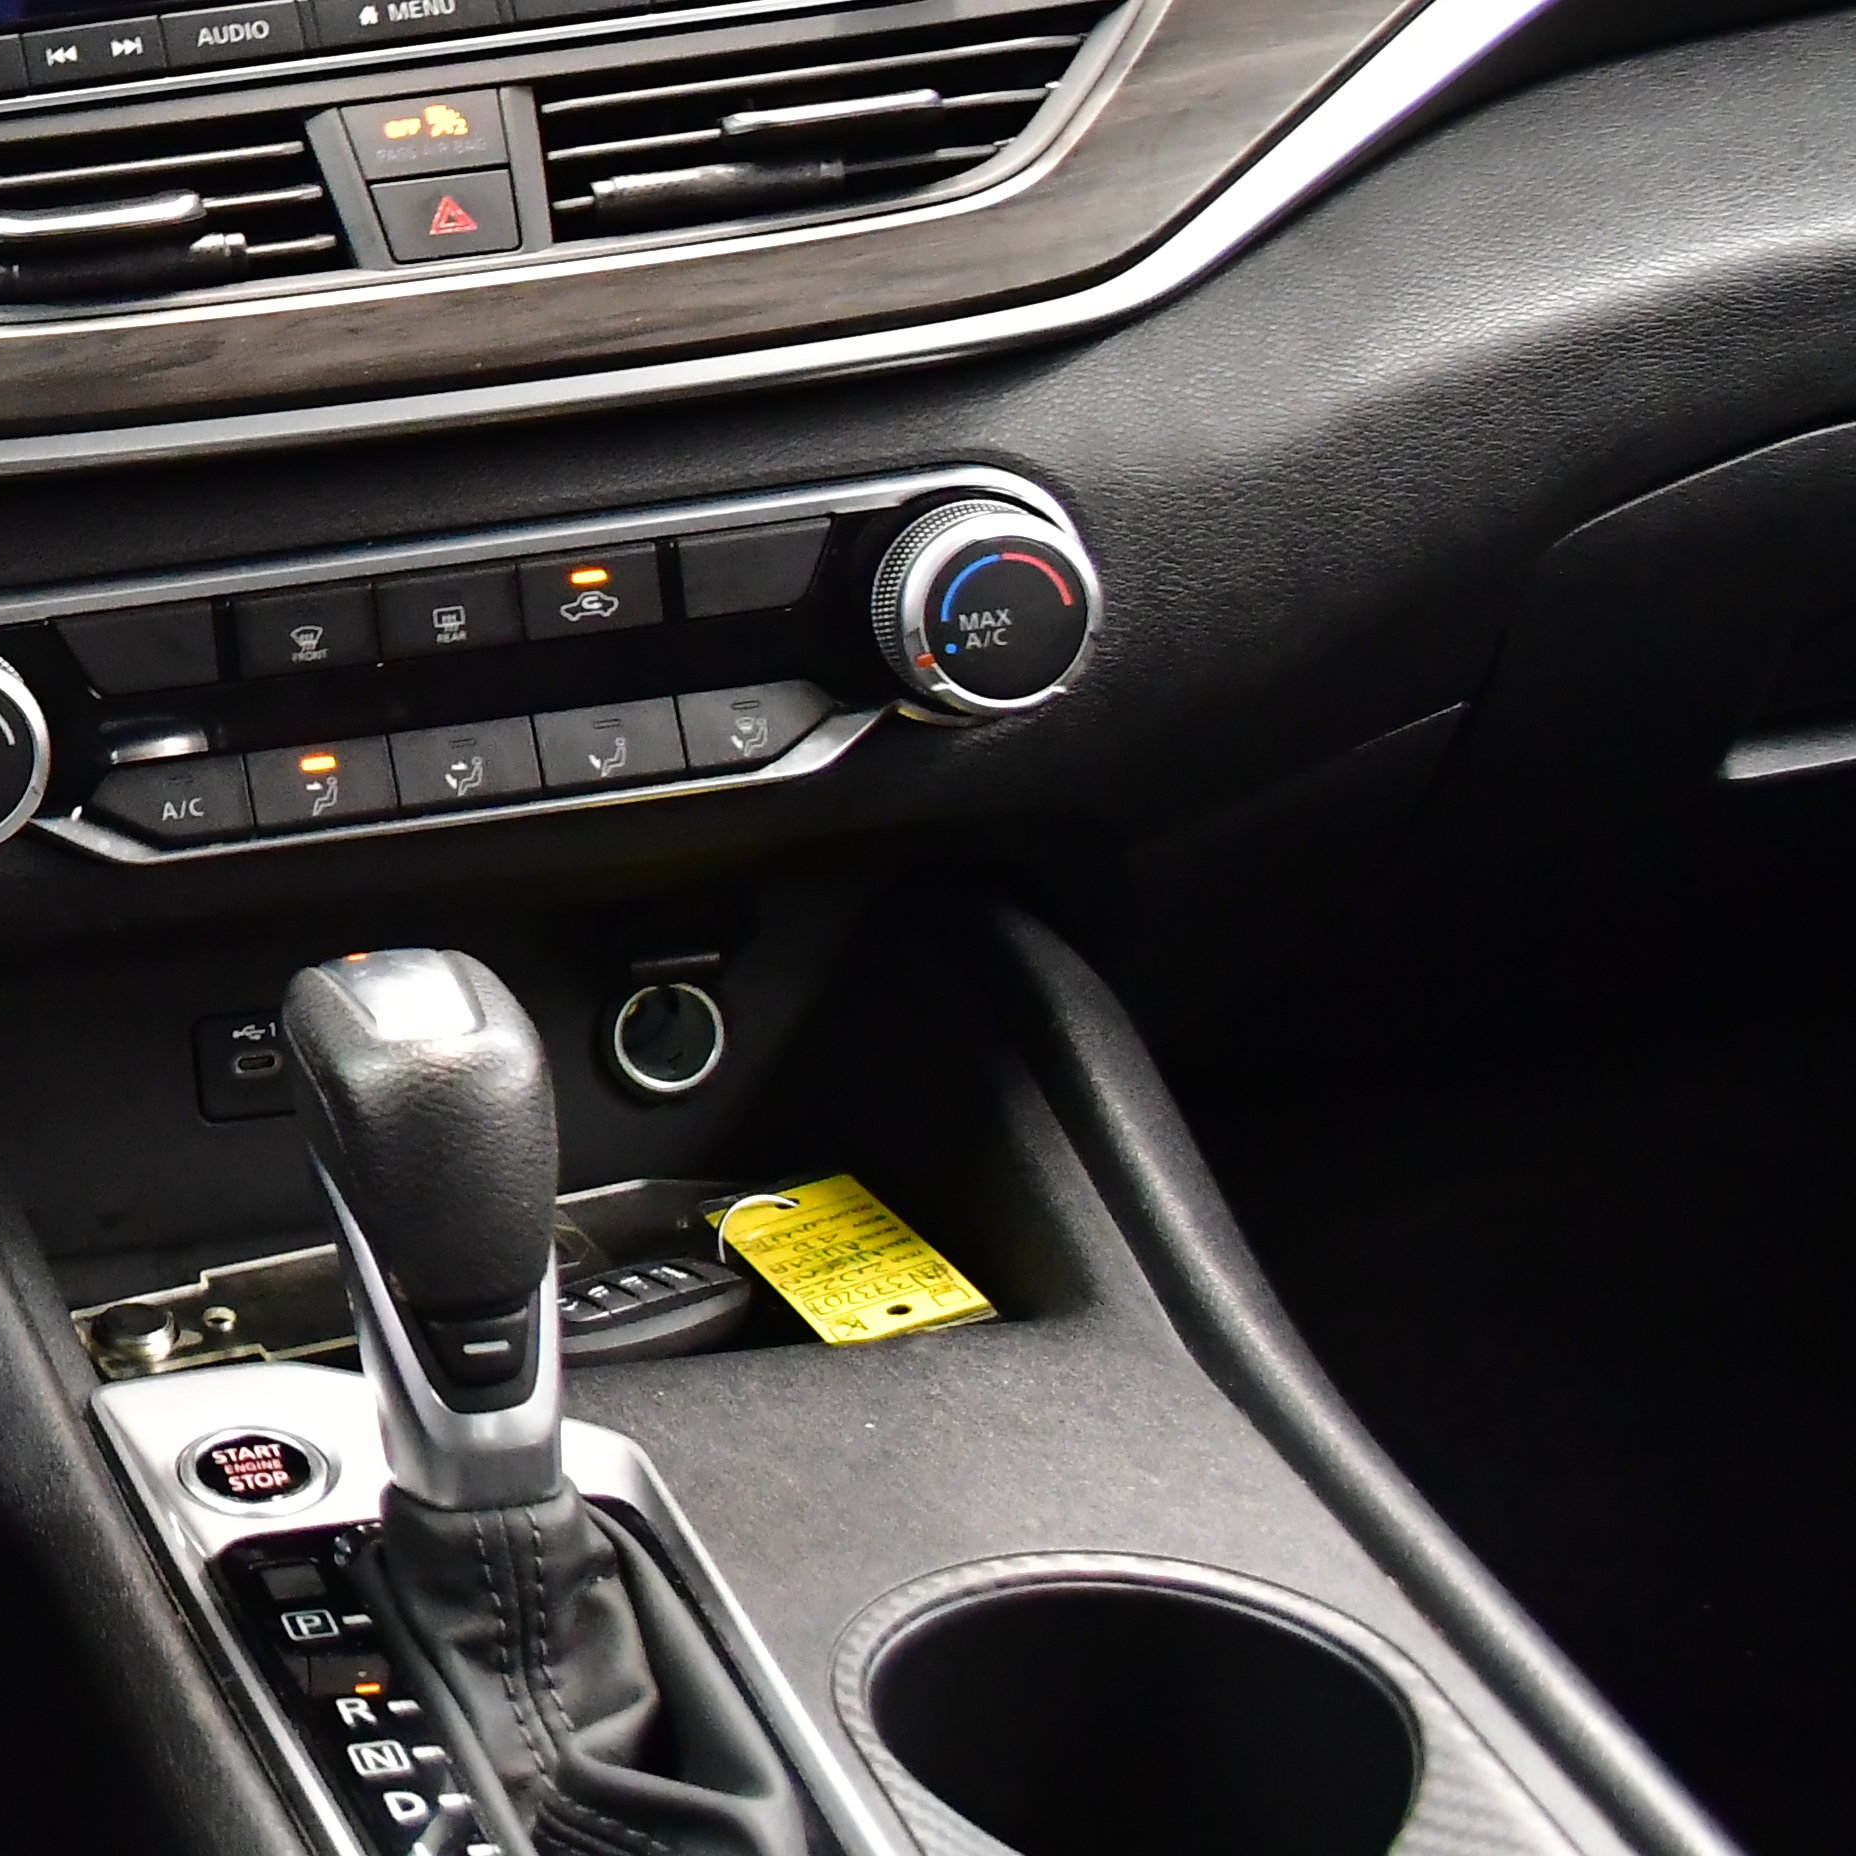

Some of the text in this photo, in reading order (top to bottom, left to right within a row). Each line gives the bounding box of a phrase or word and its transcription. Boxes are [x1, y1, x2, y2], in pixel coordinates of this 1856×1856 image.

[197, 19, 270, 47] AUDIO
[957, 608, 1012, 632] MAX
[437, 630, 467, 644] REAR
[964, 626, 1008, 651] A/C
[292, 648, 328, 662] FRONT
[162, 796, 205, 821] A/C
[212, 1444, 281, 1464] START
[224, 1459, 282, 1474] ENGINE
[228, 1471, 290, 1493] STOP
[296, 1615, 322, 1636] P
[336, 1698, 377, 1727] R
[359, 1746, 397, 1770] N
[384, 1791, 428, 1825] D
